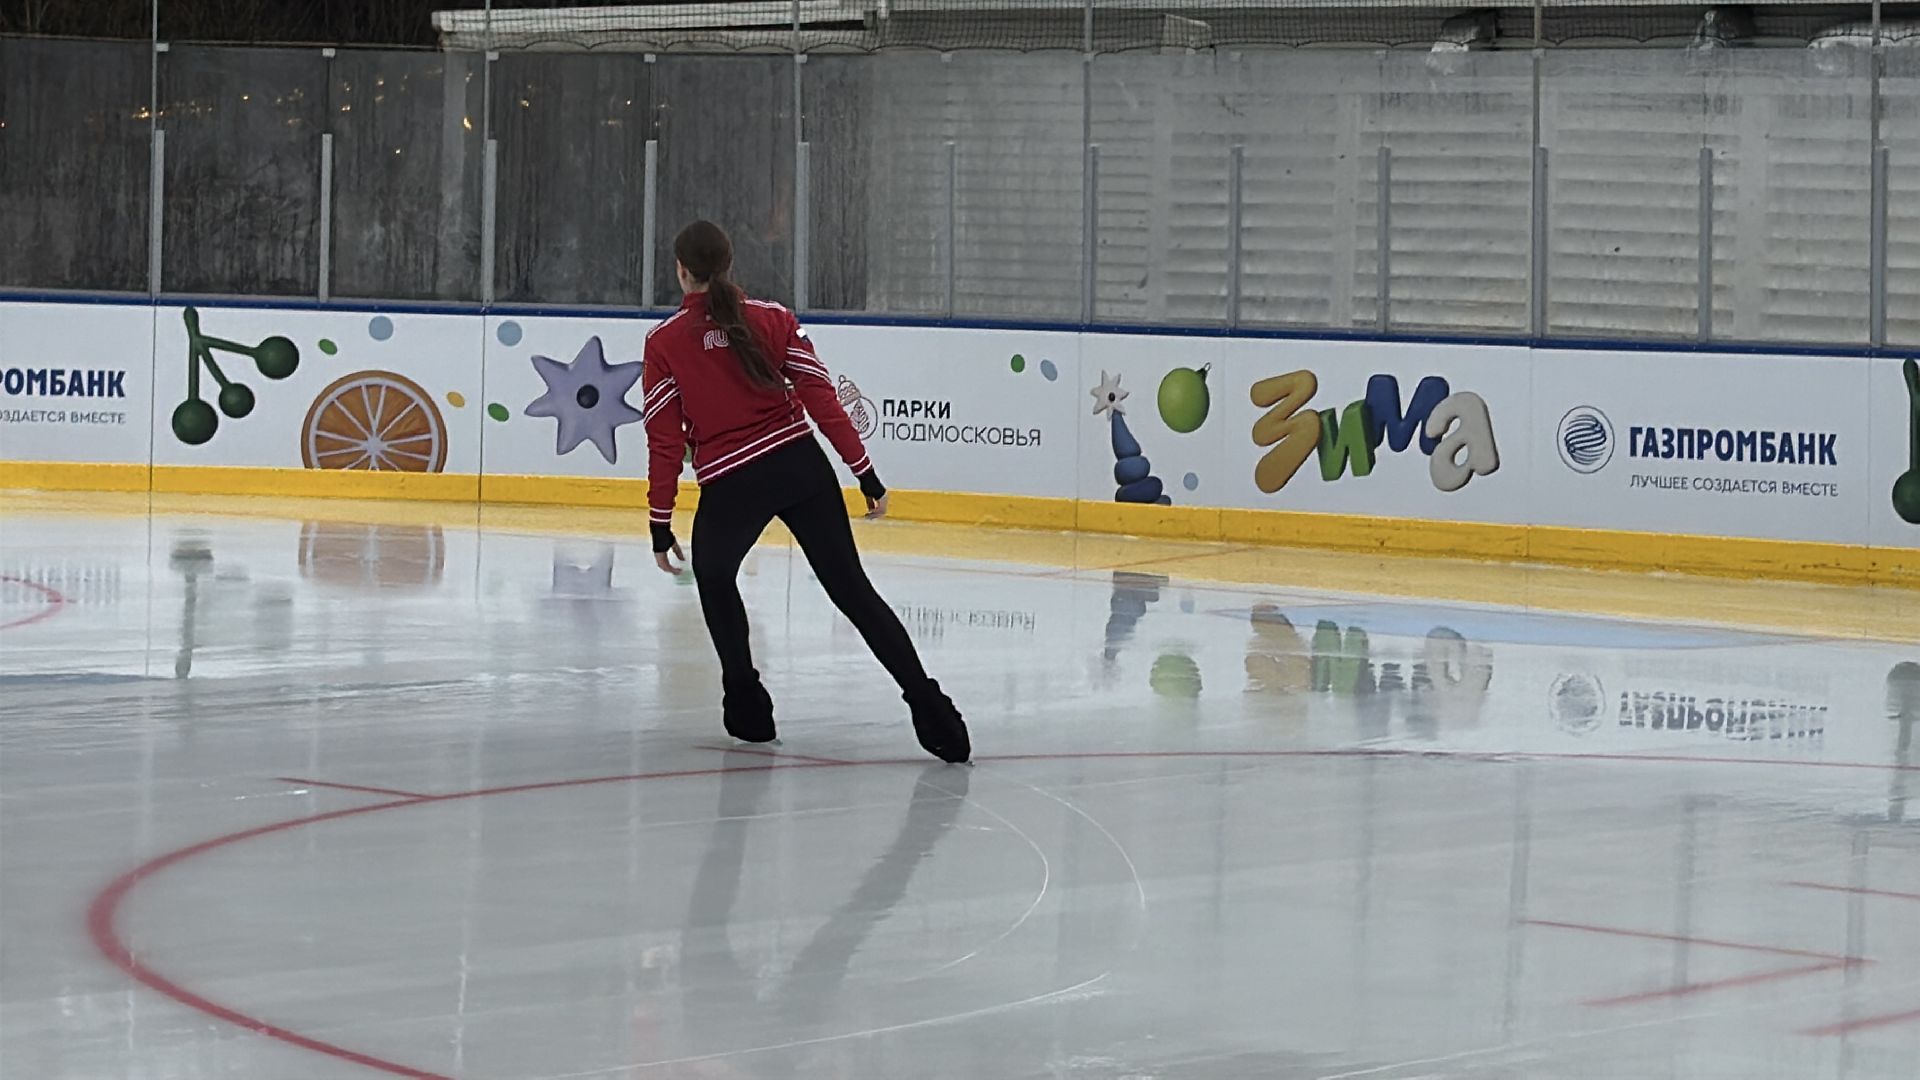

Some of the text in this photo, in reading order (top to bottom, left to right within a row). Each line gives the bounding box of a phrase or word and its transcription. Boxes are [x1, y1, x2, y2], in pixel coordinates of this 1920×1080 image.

[0, 368, 126, 398] ОМБАНК
[0, 409, 127, 425] ЗДАЕТСЯ ВМЕСТЕ
[883, 399, 951, 420] ПАРКИ
[882, 422, 1041, 447] ПОДМОСКОВЬЯ
[1629, 426, 1838, 466] ГАЗПРОМБАНК
[1630, 474, 1839, 497] ЛУЧШЕЕ СОЗДАЕТСЯ ВМЕСТЕ
